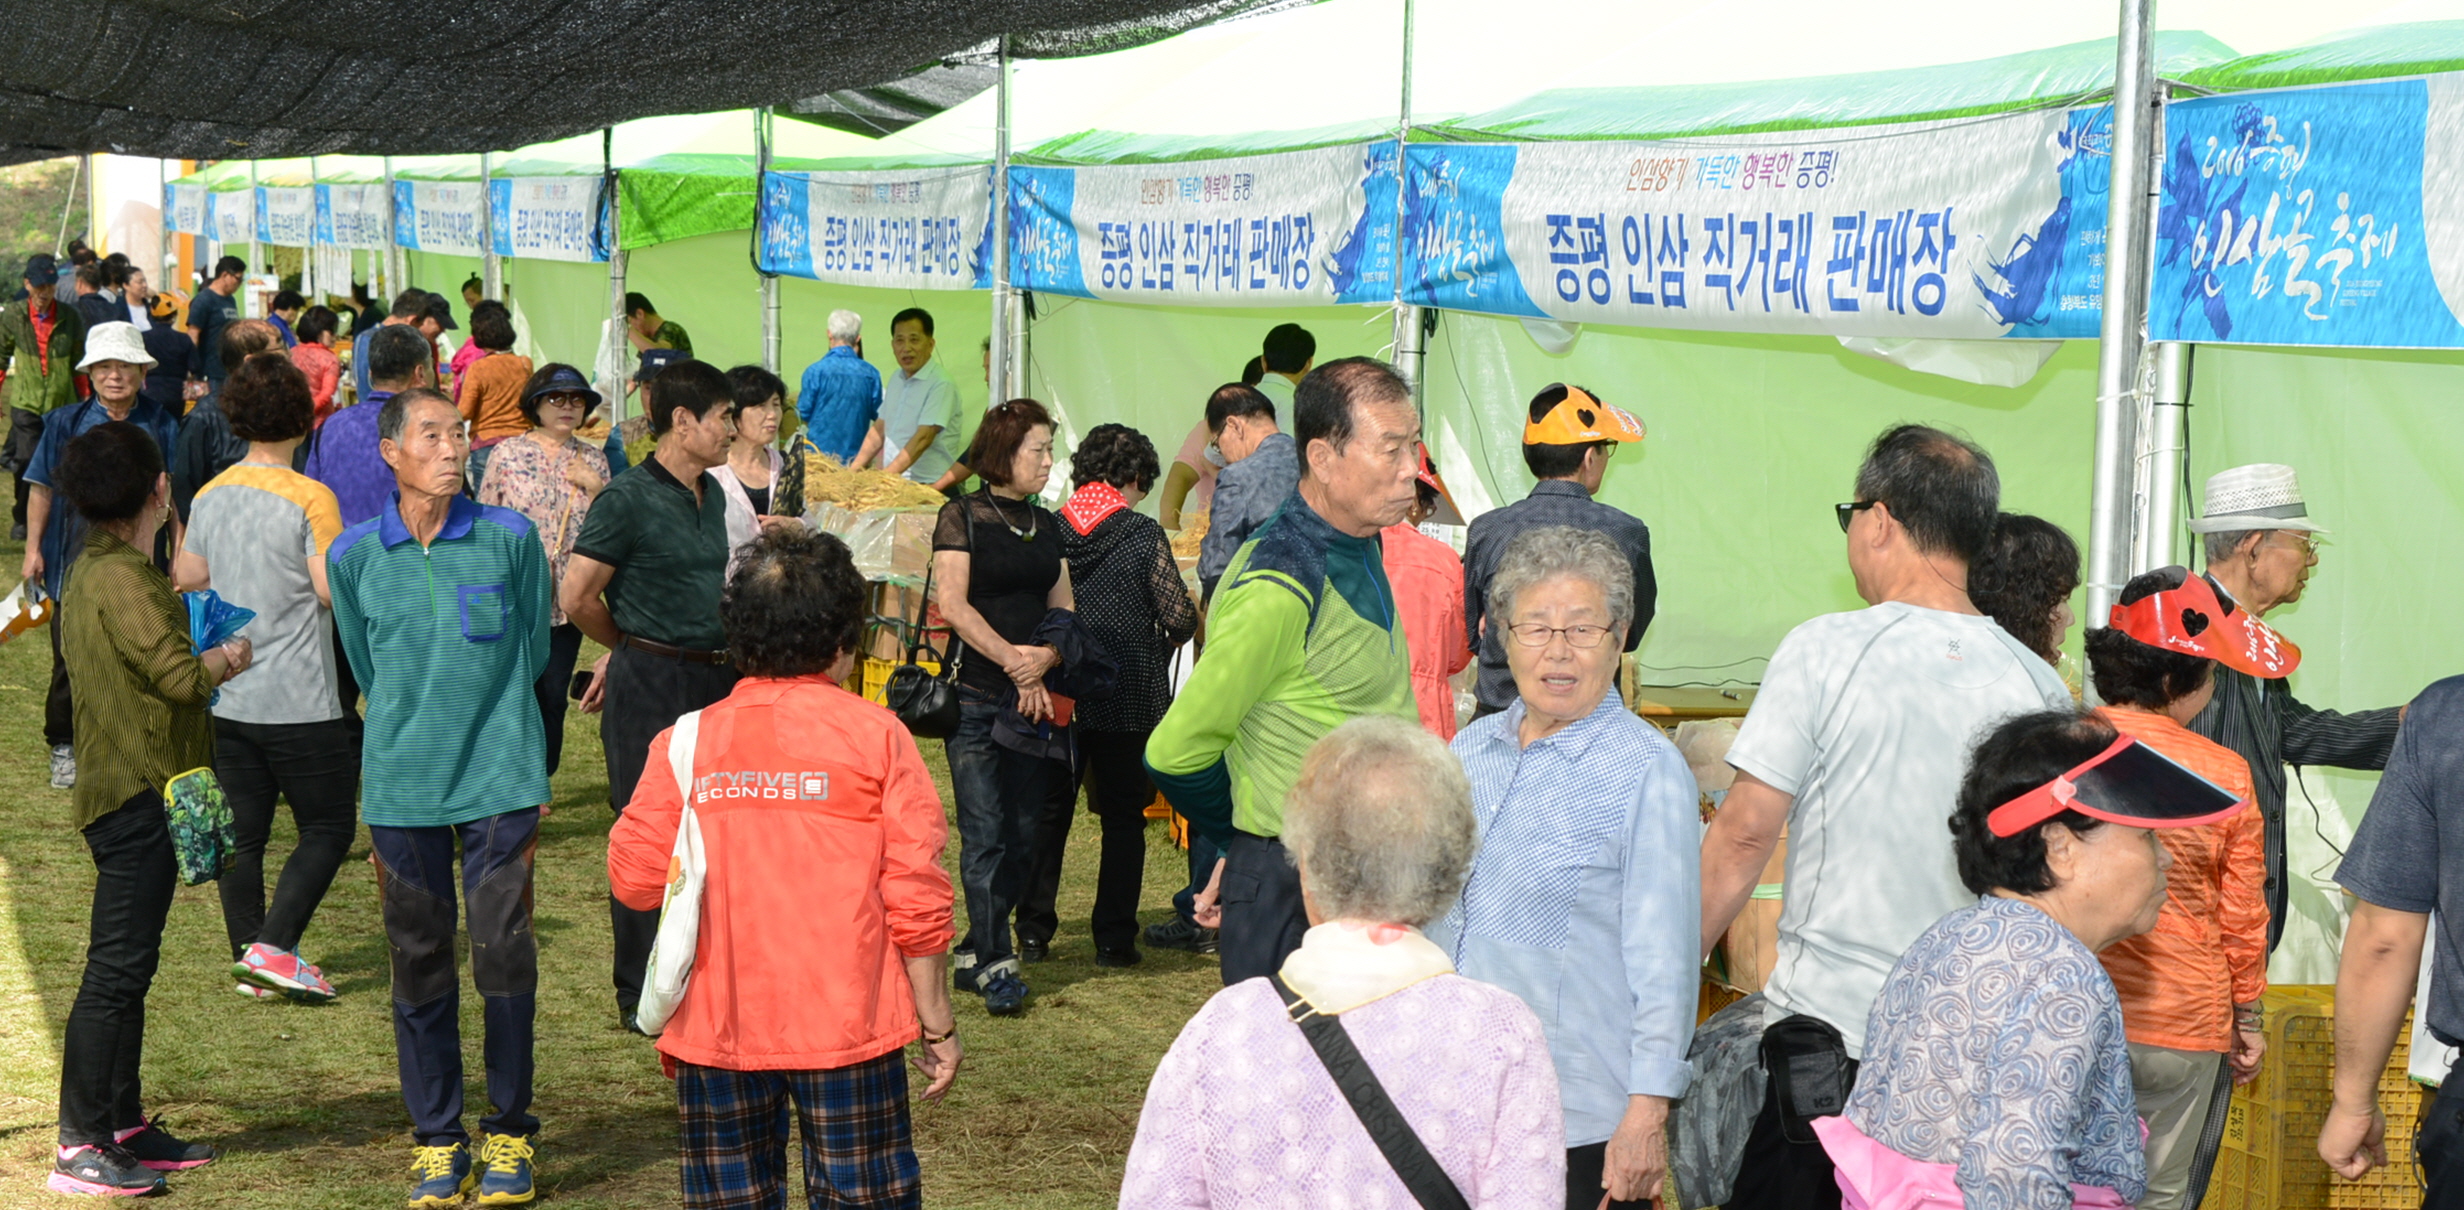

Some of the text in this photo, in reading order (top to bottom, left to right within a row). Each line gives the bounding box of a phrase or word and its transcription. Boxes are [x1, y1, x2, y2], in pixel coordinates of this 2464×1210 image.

[1626, 150, 1839, 191] 인삼향기 가득한 행복한 증평!
[2202, 115, 2310, 200] 2016 증평
[1177, 176, 1203, 203] 가득한
[1204, 173, 1231, 203] 행복한
[824, 216, 961, 276] 증평 인삼 직거래 판매장
[1098, 212, 1315, 292] 증평 인삼 직거래 판매장
[1546, 207, 1956, 316] 증평 인삼 직거래 판매장
[694, 771, 797, 793] IFTYFIVE
[697, 787, 797, 804] ECONDS
[1306, 1019, 1426, 1183] ANNA CRISTINA
[1813, 1096, 1835, 1109] K2
